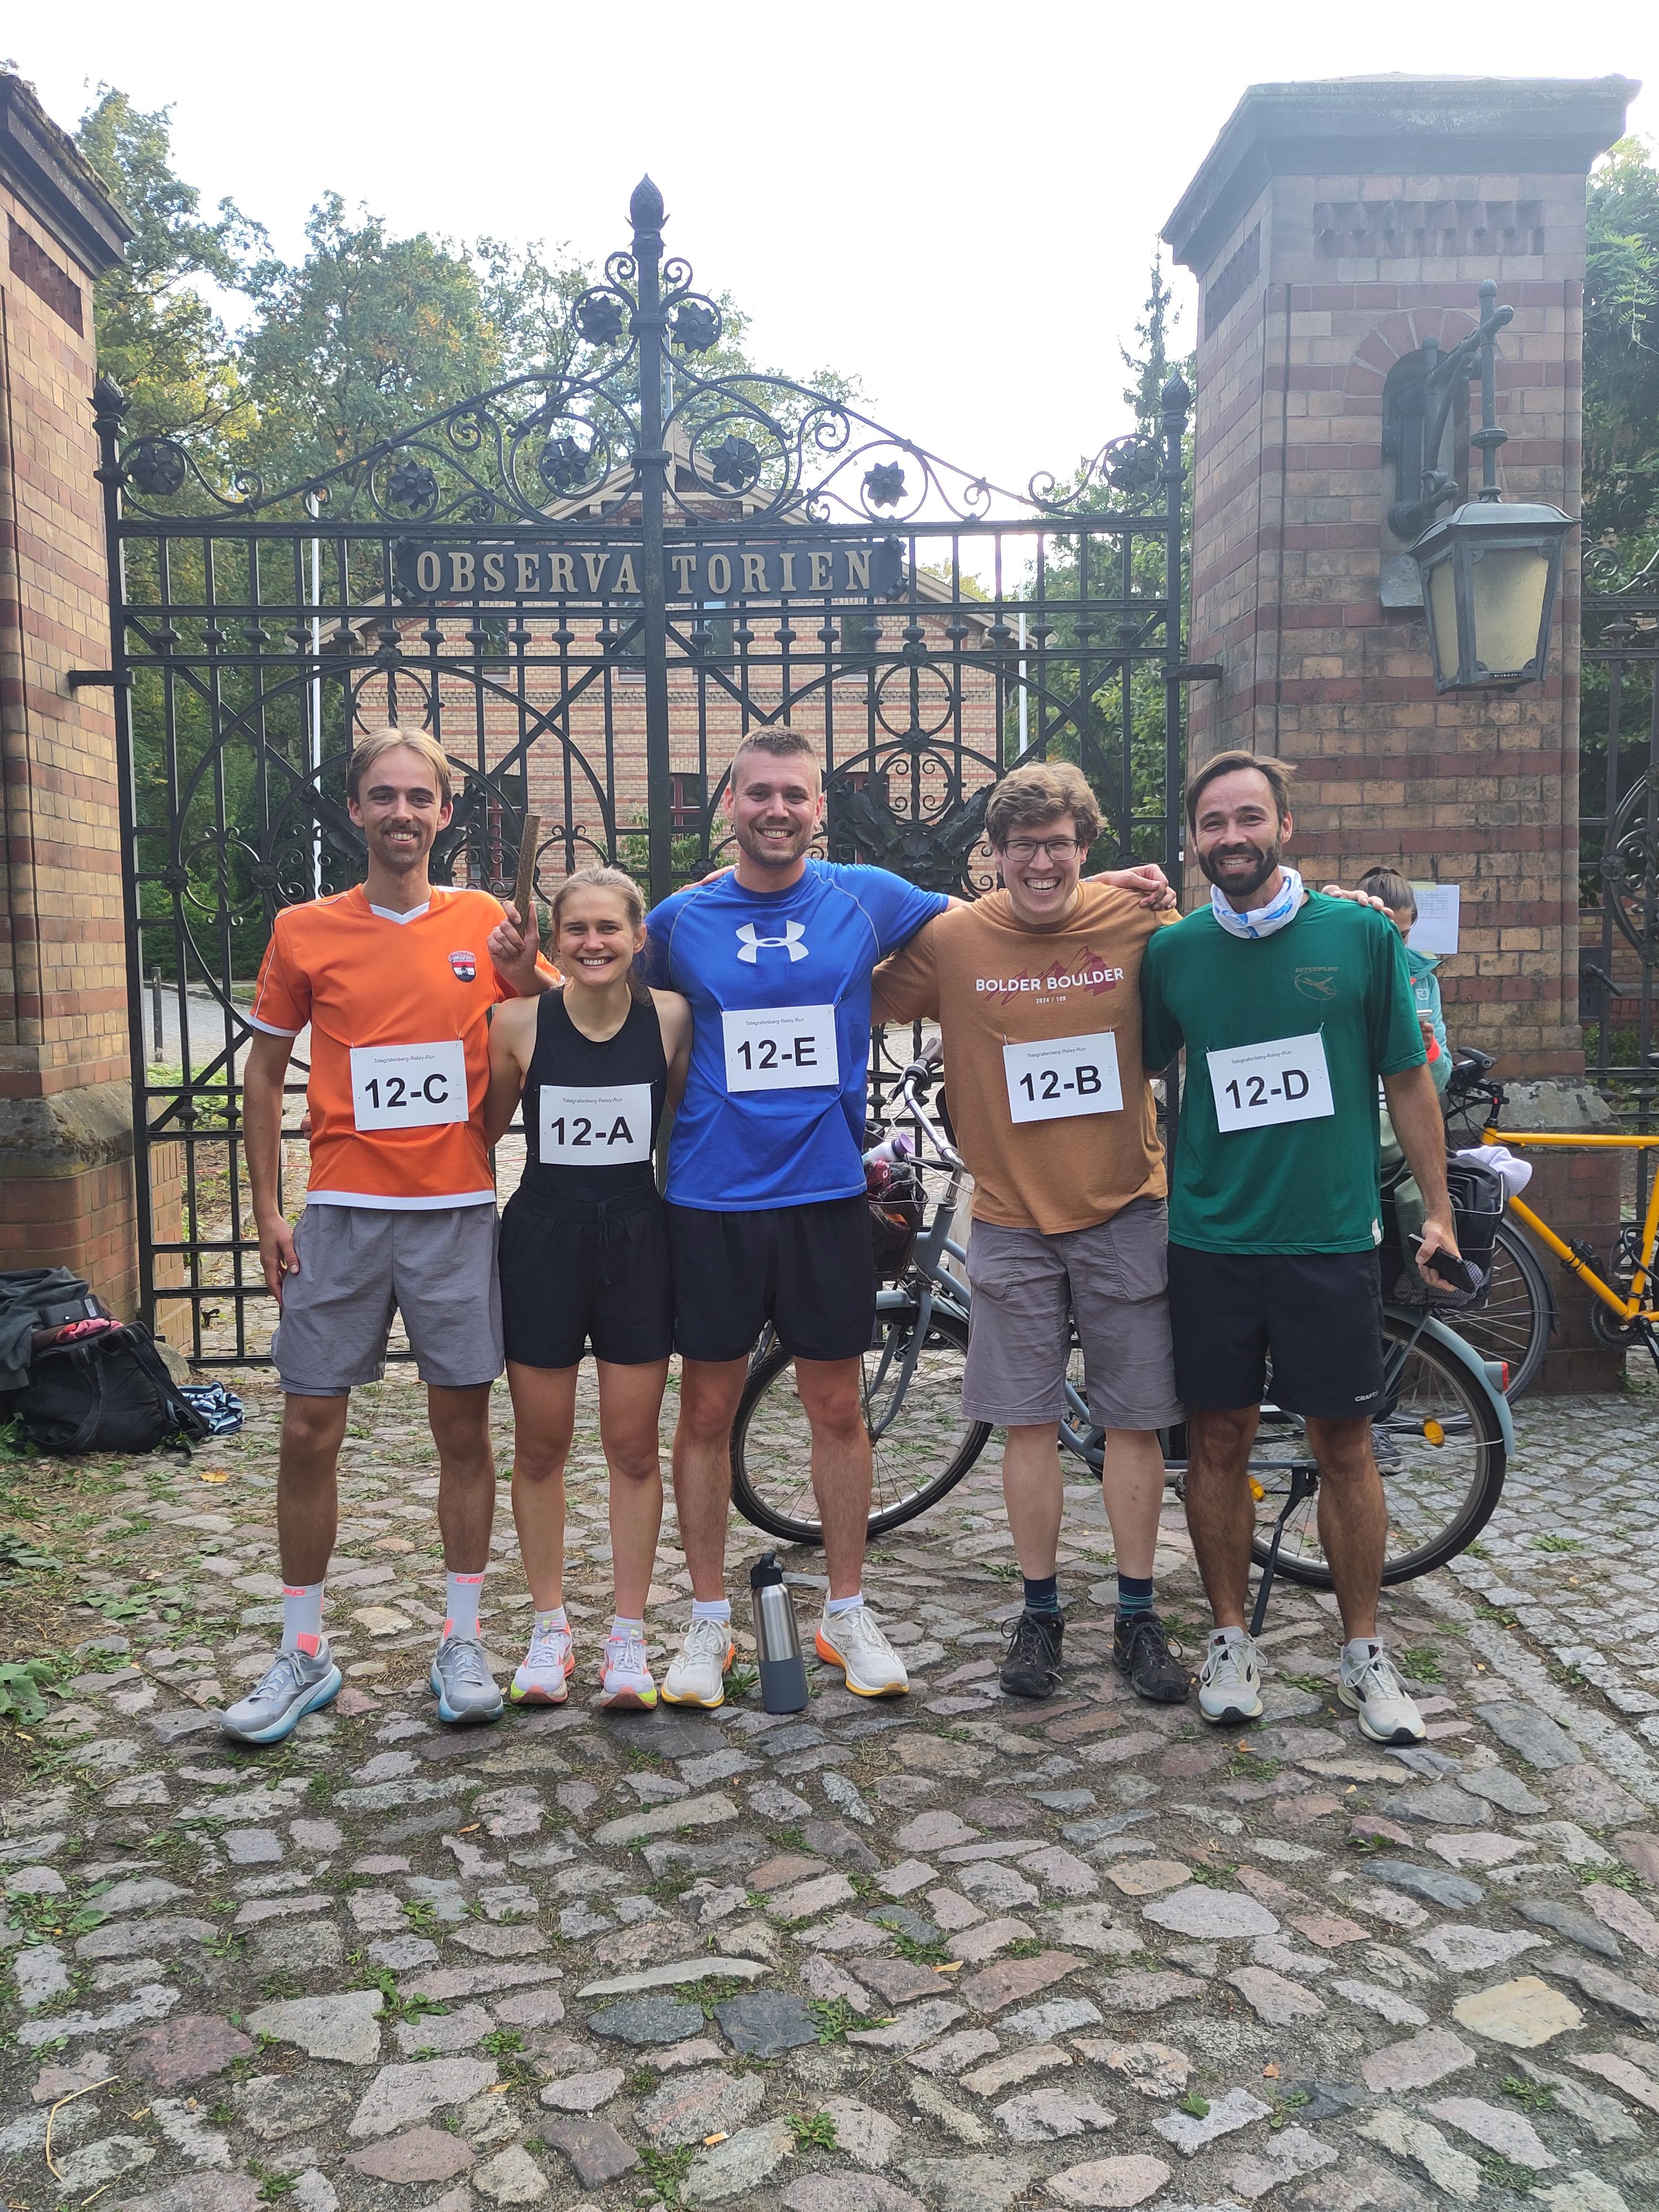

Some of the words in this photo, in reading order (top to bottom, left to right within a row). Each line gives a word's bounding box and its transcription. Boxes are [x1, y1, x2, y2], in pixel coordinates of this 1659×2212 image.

[975, 978, 1041, 992] BOLDER
[1046, 968, 1125, 990] BOULDER
[737, 1036, 817, 1070] 12-E
[365, 1073, 449, 1109] 12-C
[1020, 1065, 1102, 1102] 12-B
[1225, 1069, 1309, 1109] 12-D
[551, 1116, 634, 1146] 12-A
